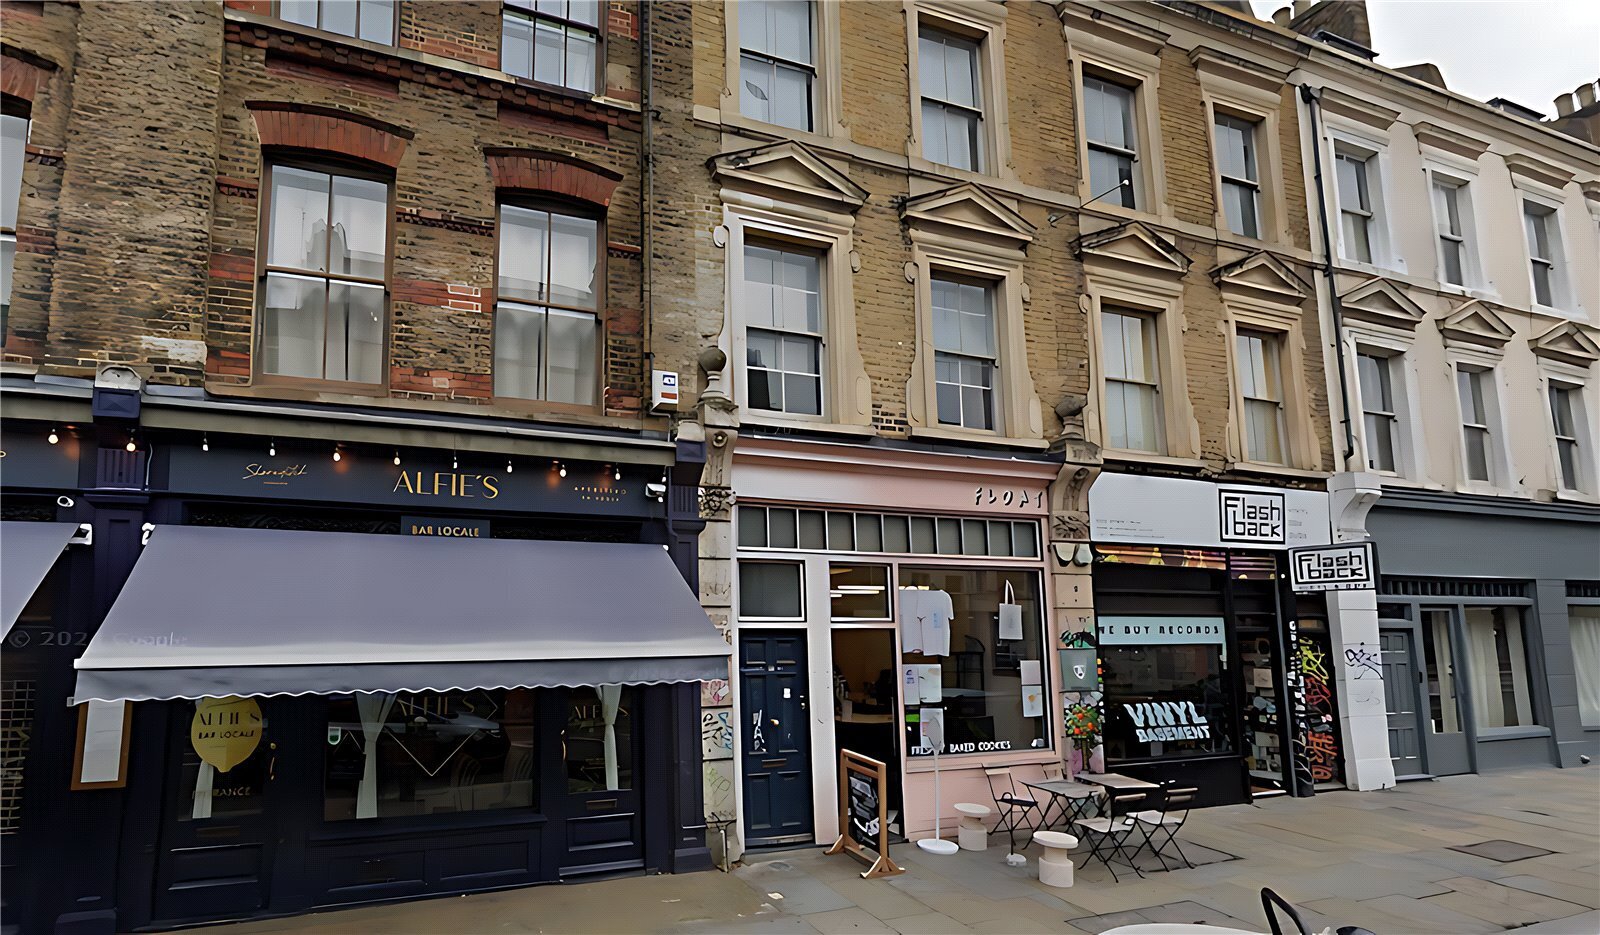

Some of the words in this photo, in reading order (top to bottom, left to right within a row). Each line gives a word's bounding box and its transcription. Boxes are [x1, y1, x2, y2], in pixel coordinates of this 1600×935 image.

[393, 470, 499, 499] ALFIE'S
[975, 487, 1044, 508] FLOAT
[1224, 496, 1281, 528] Flash
[412, 525, 433, 535] BAR
[437, 526, 479, 537] LOCALE
[1233, 521, 1281, 537] back
[1299, 551, 1363, 572] Flash
[1307, 566, 1363, 578] back
[1123, 701, 1208, 726] VINYL
[1136, 725, 1211, 743] BASEMENT
